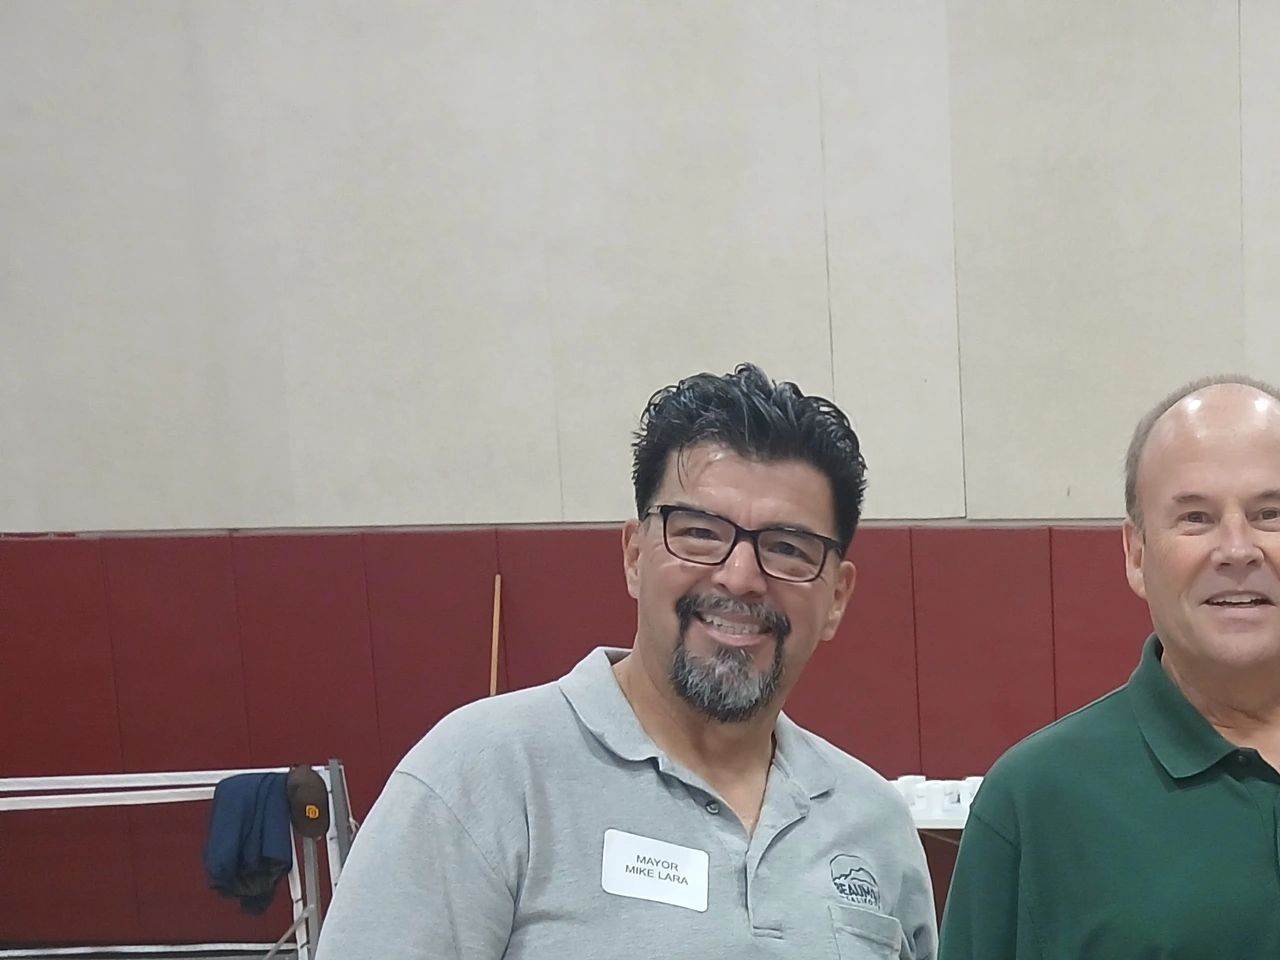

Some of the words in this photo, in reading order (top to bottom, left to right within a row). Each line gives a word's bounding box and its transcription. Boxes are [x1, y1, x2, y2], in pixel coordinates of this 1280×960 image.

[636, 854, 679, 872] MAYOR
[625, 864, 655, 878] MIKE
[658, 871, 689, 886] LARA
